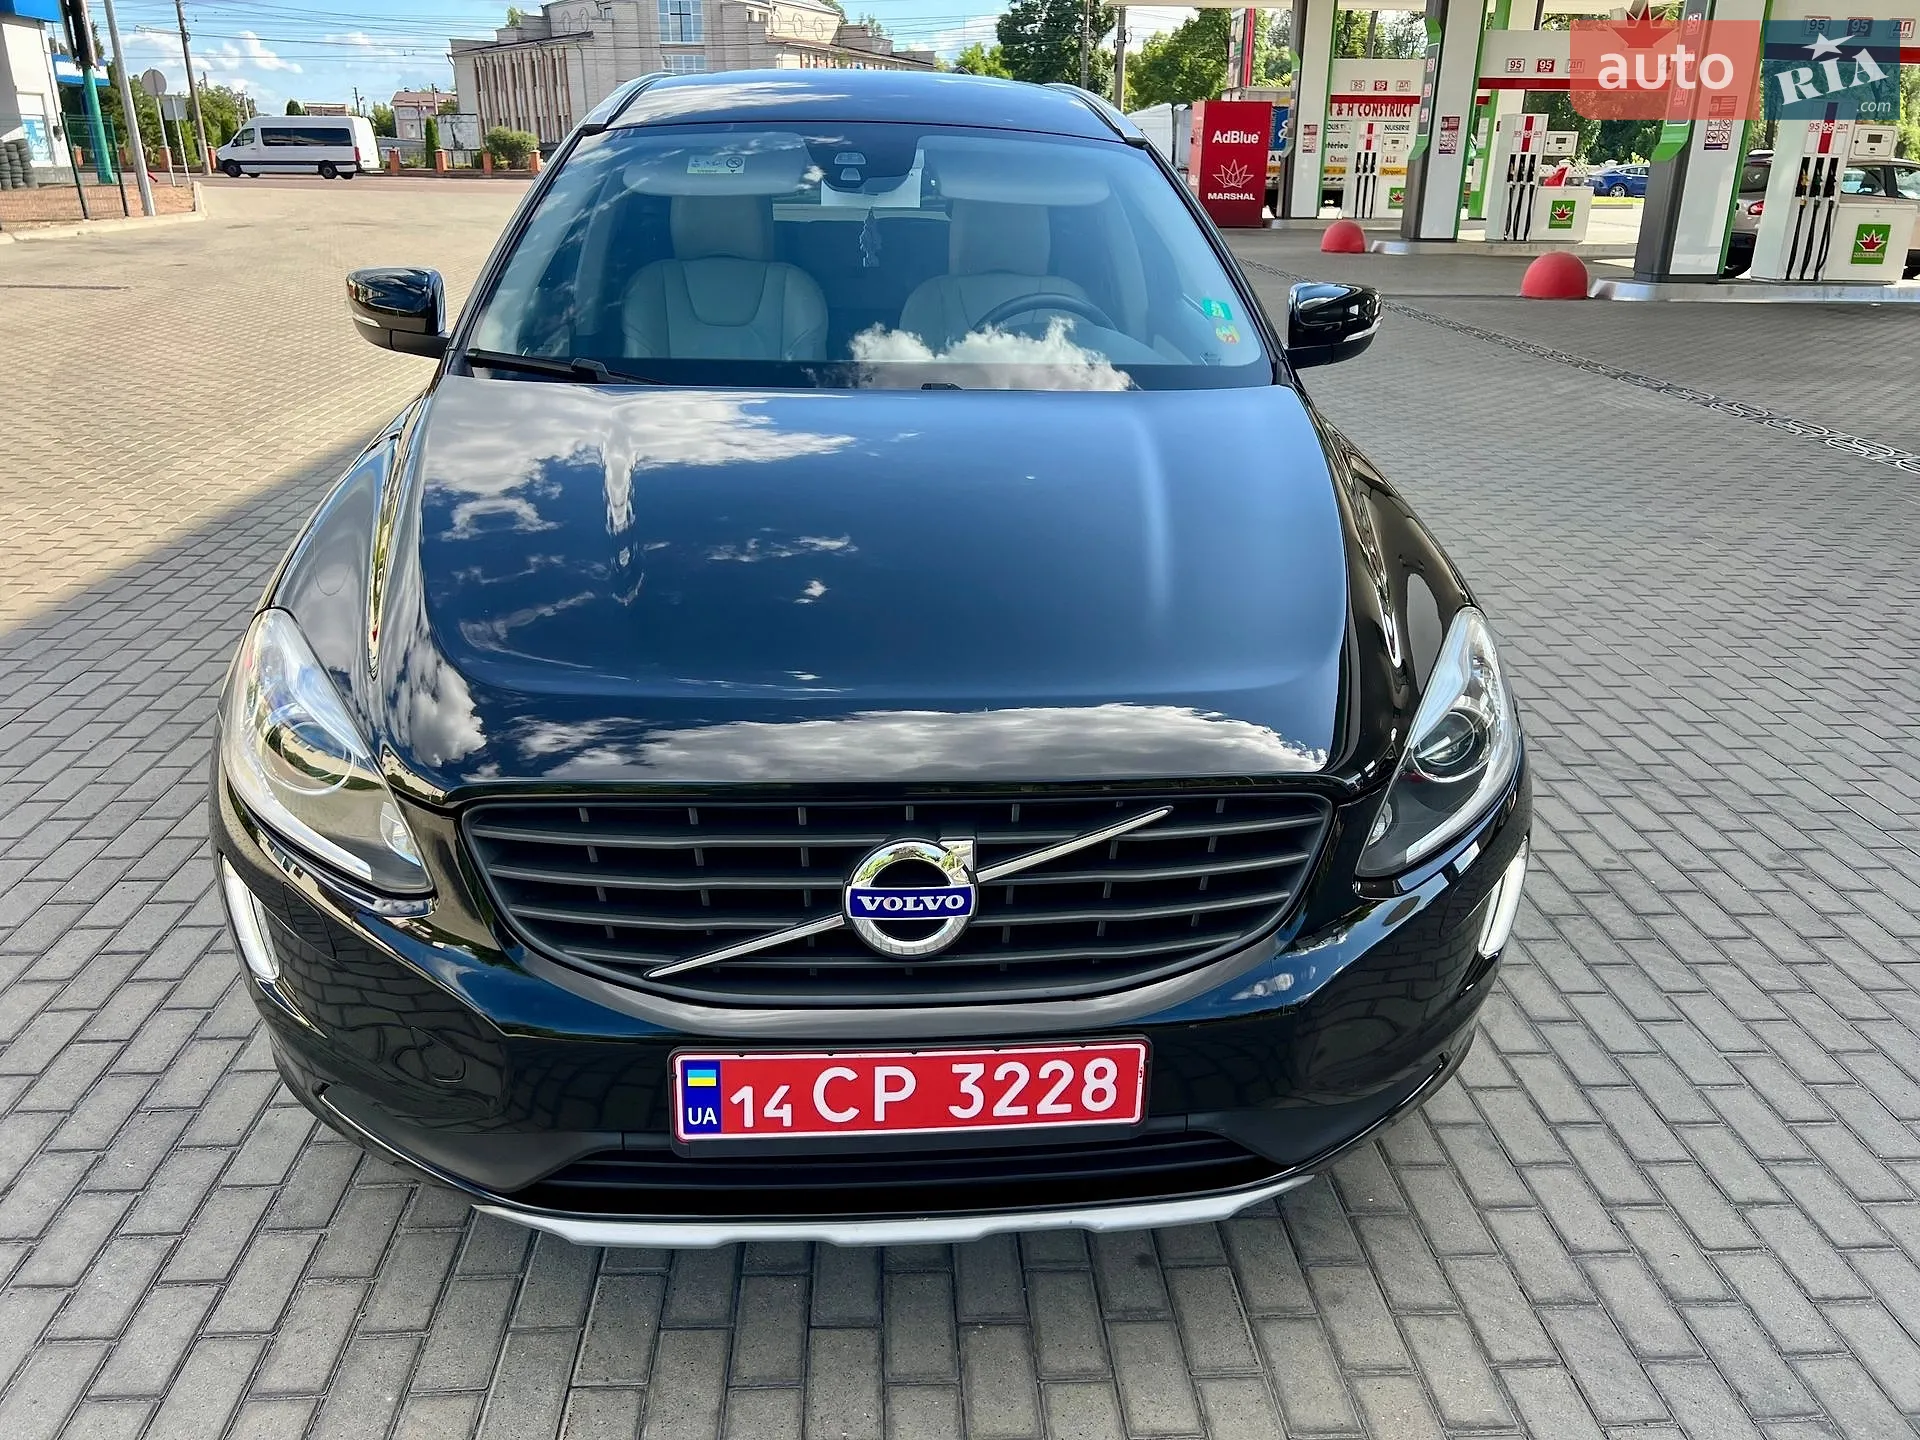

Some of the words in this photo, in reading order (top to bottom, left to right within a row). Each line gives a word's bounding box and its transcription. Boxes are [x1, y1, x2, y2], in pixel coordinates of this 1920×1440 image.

[1809, 20, 1825, 31] 95
[1851, 20, 1869, 32] 95
[1893, 21, 1911, 31] ДП
[1510, 60, 1522, 69] 95
[1539, 60, 1552, 69] 95
[1358, 103, 1412, 117] CONSTRUCT
[1212, 130, 1259, 144] AdBlue
[1207, 192, 1256, 200] MARSHAL
[857, 895, 965, 911] VOLVO
[729, 1085, 792, 1127] 14
[813, 1065, 917, 1123] CP
[948, 1057, 1118, 1119] 3228
[688, 1106, 717, 1125] UA
